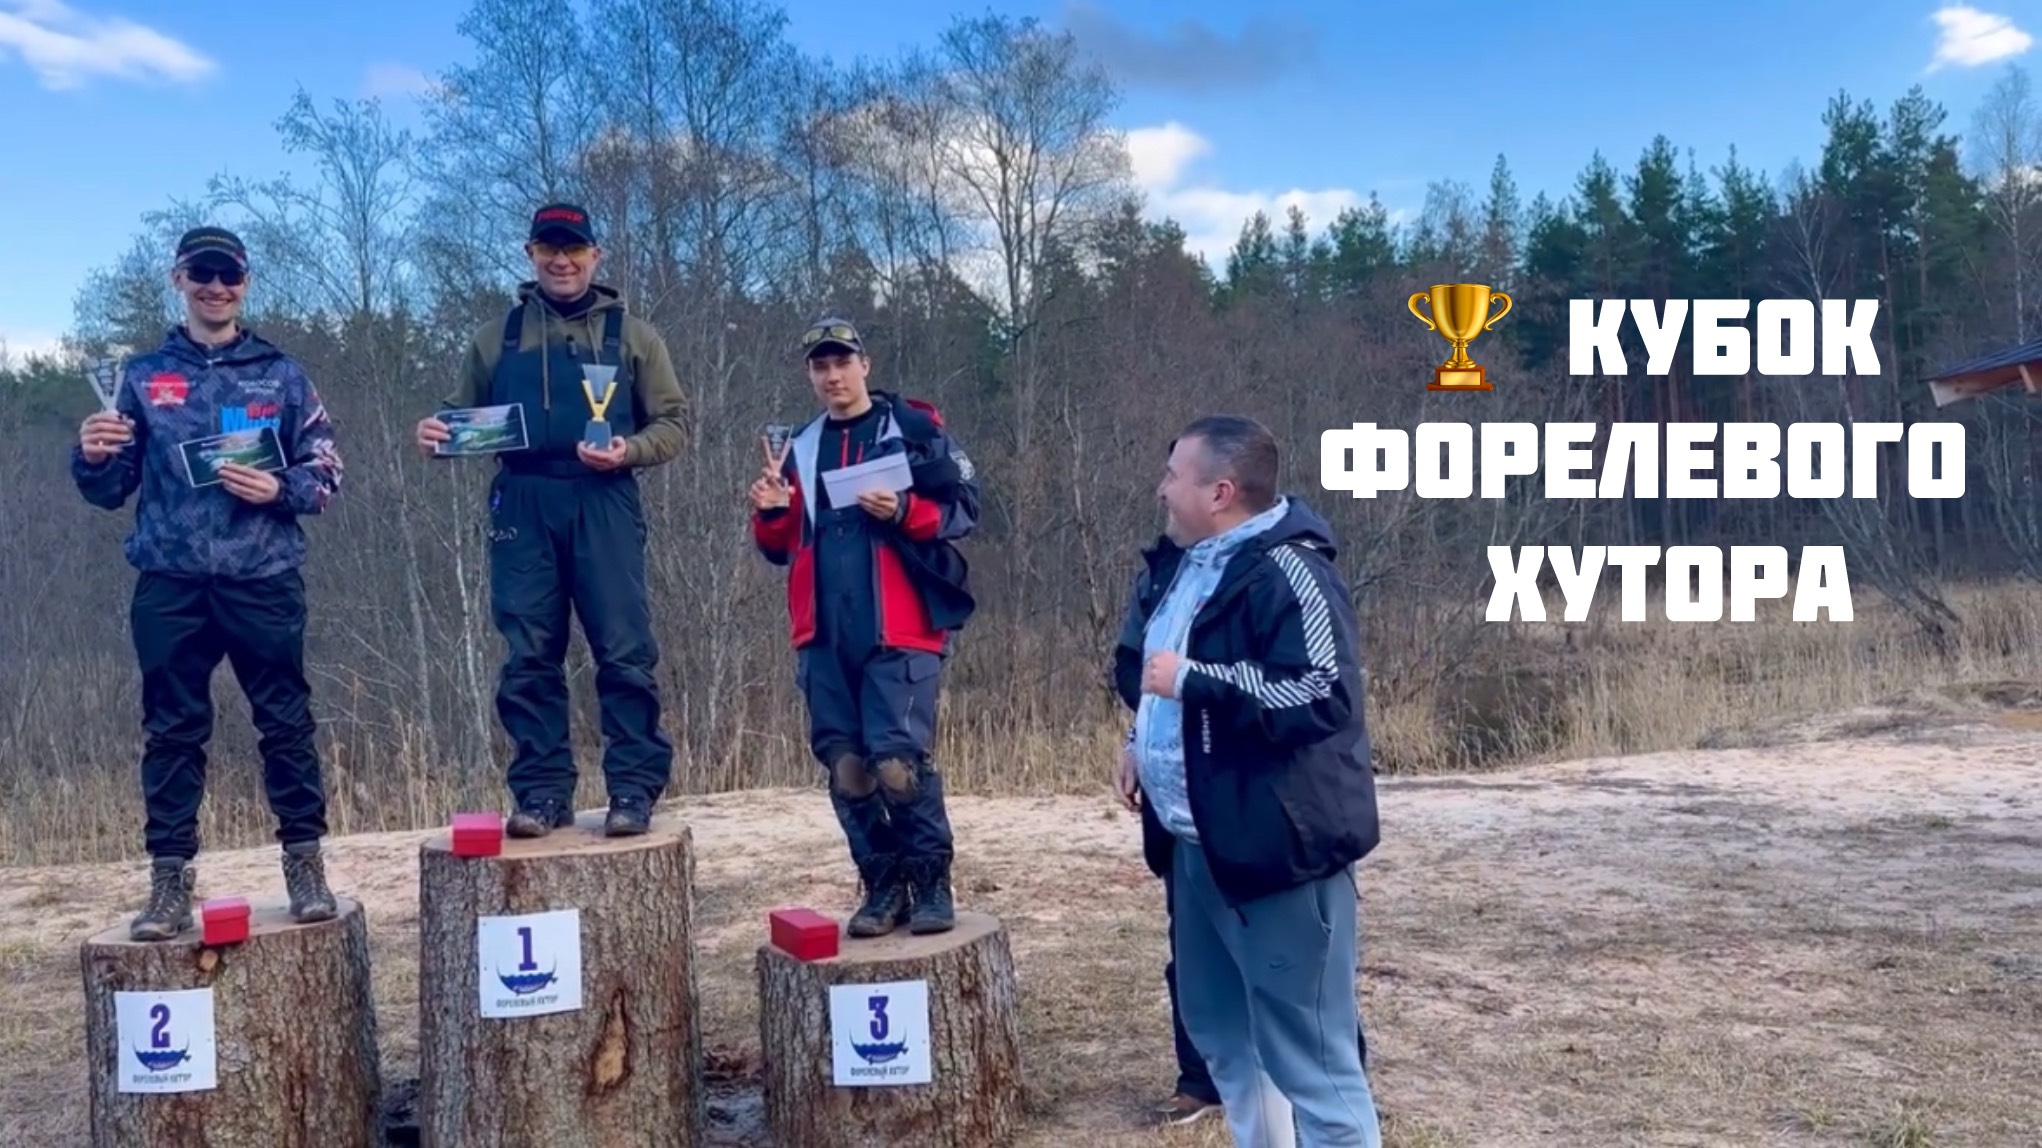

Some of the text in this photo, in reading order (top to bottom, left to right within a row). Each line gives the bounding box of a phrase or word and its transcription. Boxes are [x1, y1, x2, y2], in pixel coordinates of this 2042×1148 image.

[517, 927, 537, 971] 1
[150, 1003, 171, 1048] 2
[868, 995, 889, 1041] 3
